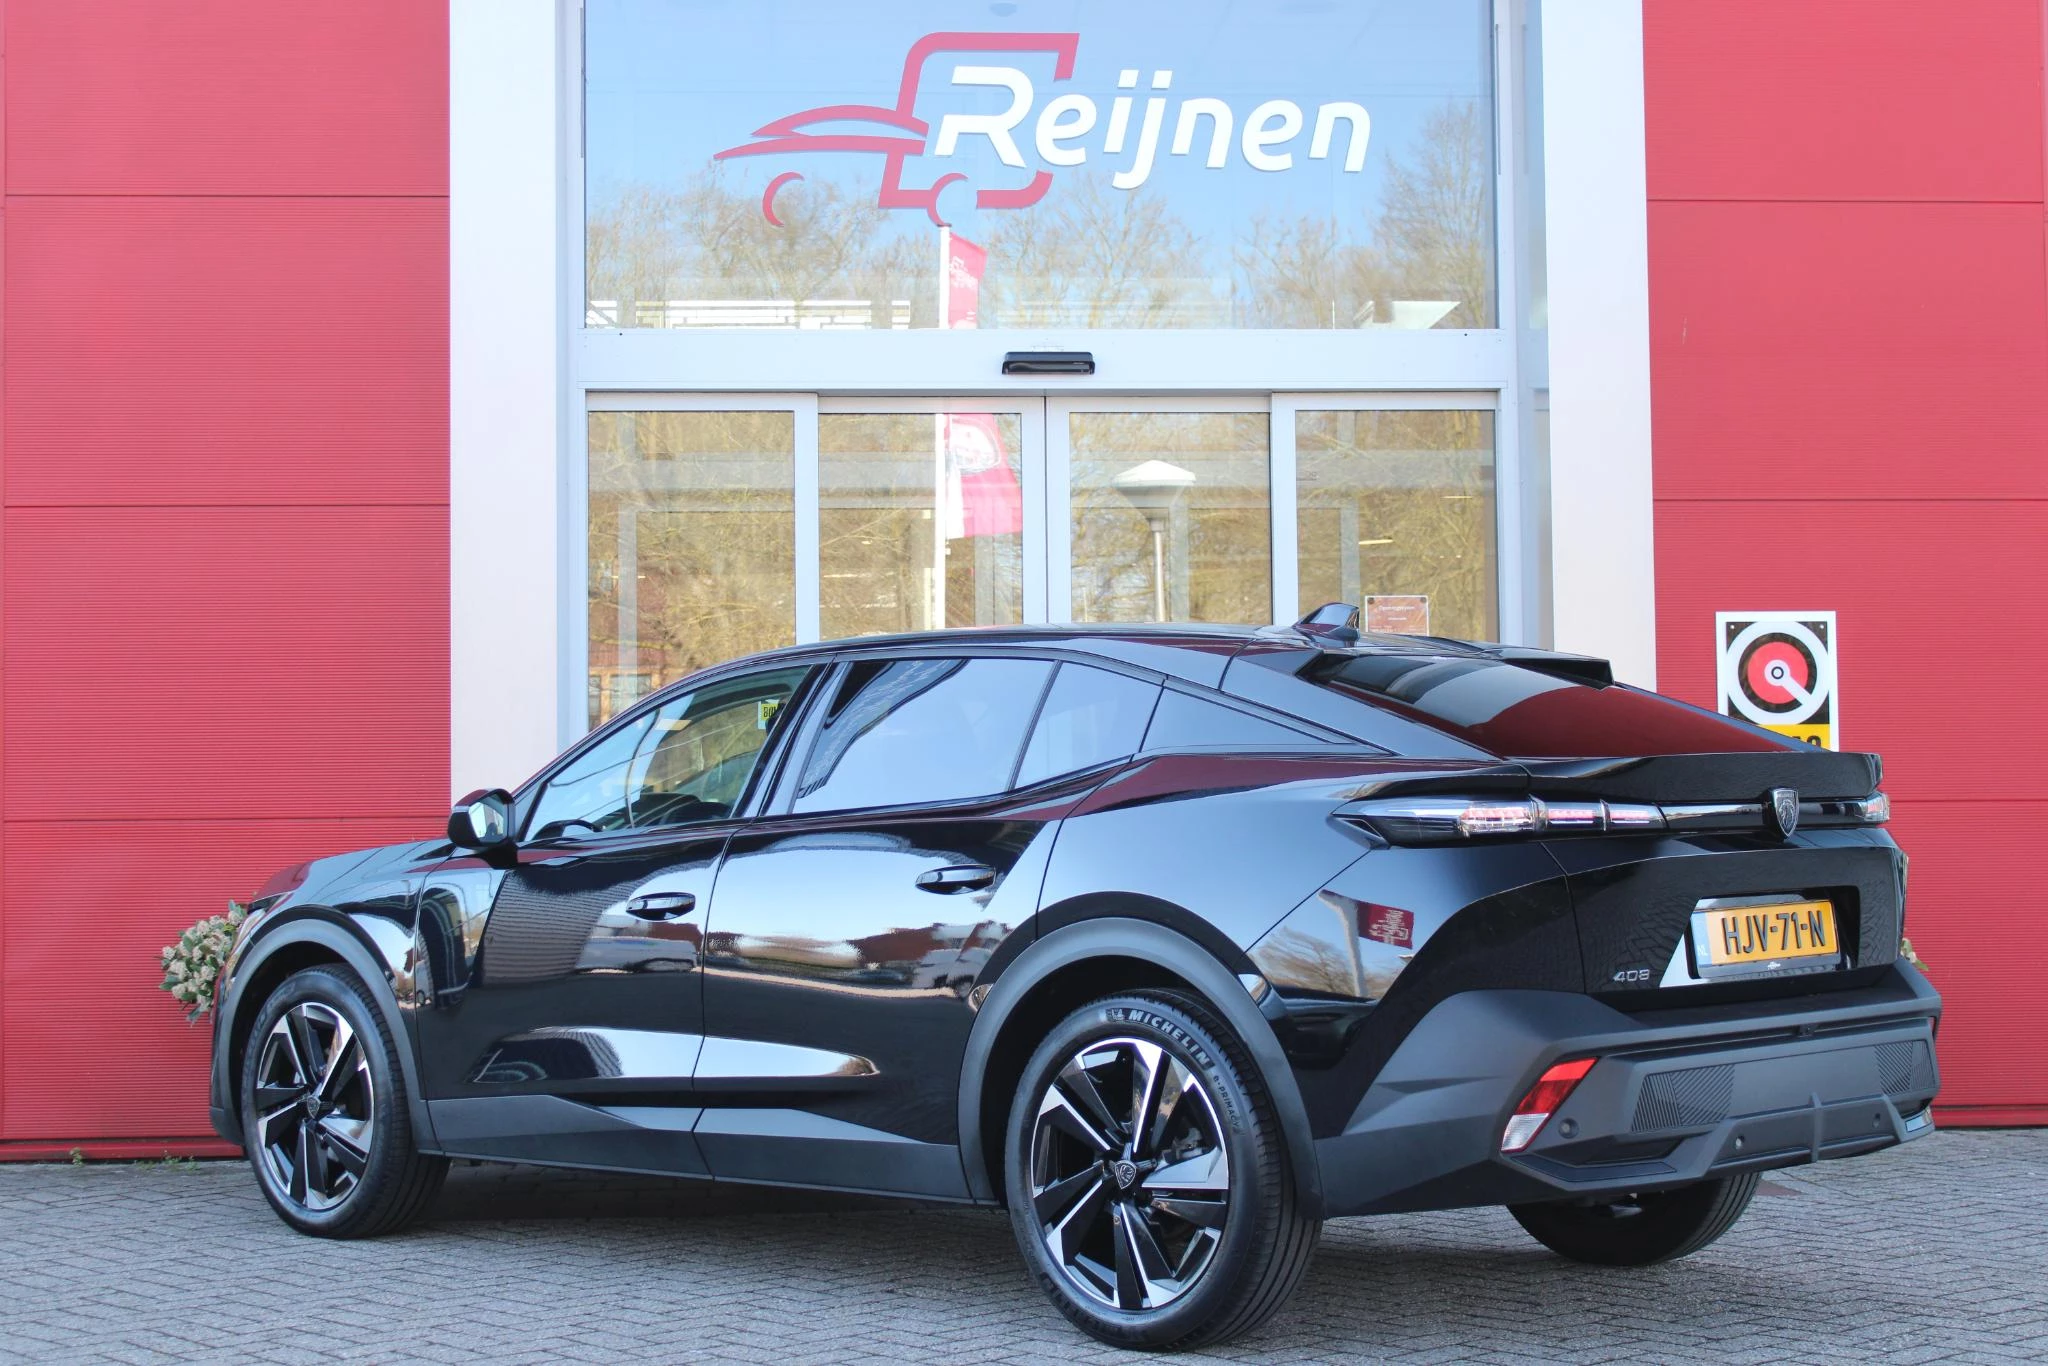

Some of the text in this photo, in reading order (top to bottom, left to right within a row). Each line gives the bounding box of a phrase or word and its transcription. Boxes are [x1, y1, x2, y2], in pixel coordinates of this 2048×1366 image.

[934, 66, 1371, 190] Reijnen
[1721, 910, 1826, 955] HJV-71-N
[1613, 969, 1649, 982] 408
[1129, 1010, 1210, 1066] MICHELIN
